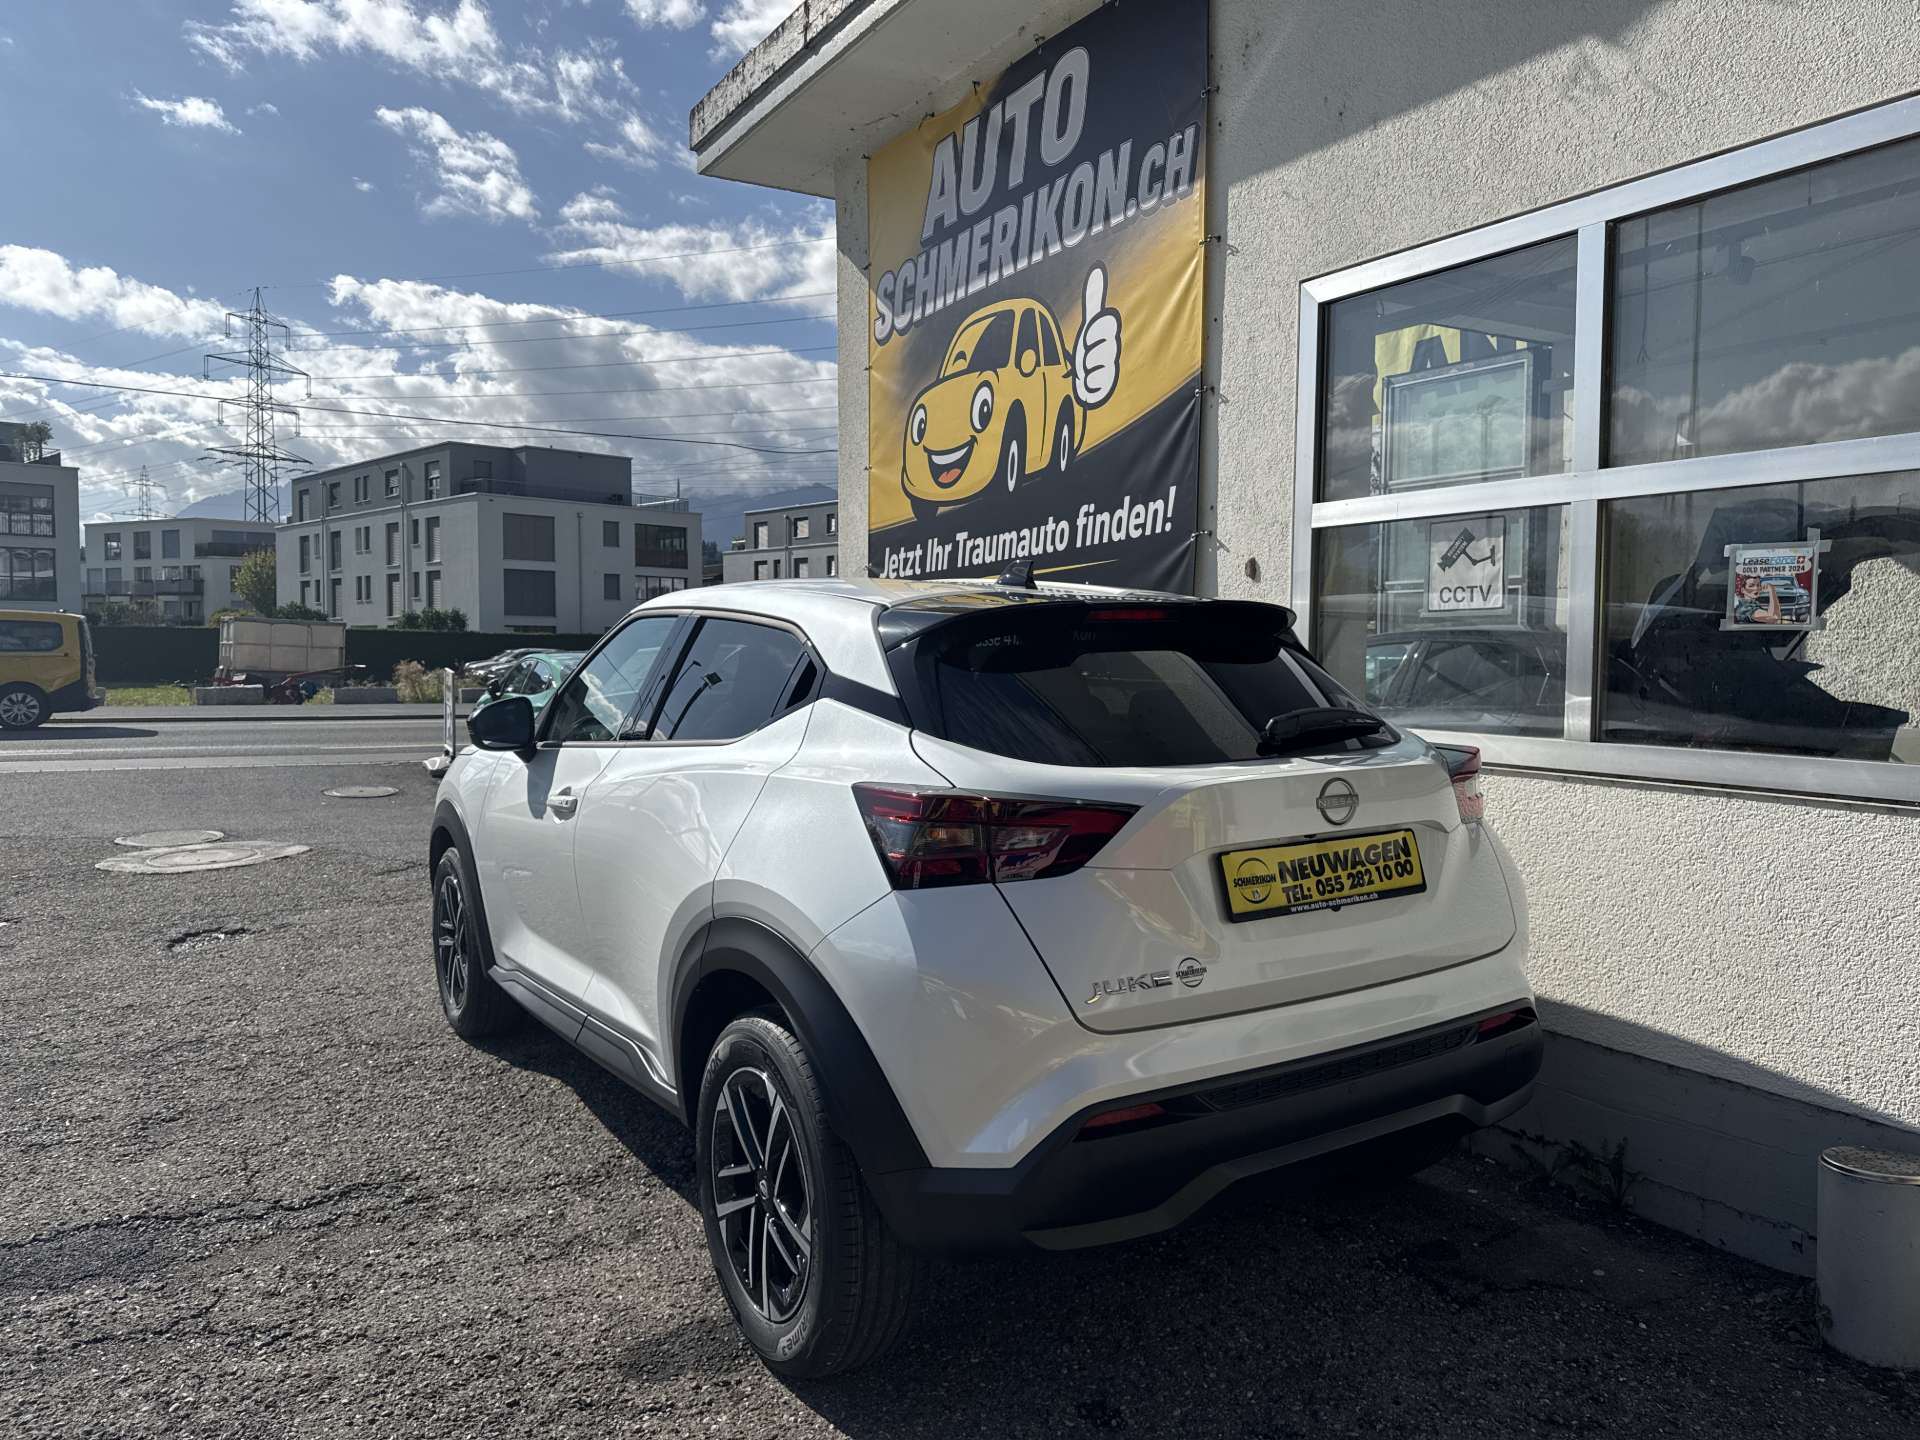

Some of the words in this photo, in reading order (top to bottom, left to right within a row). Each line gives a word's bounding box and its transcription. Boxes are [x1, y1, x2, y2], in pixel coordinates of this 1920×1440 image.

[921, 46, 1090, 244] AUTO
[874, 124, 1198, 344] SCHMERIKON.CH
[879, 547, 923, 580] Jetzt
[926, 537, 952, 572] Ihr
[956, 516, 1070, 568] Traumauto
[1076, 485, 1177, 548] finden!
[1788, 564, 1805, 573] 2024
[1439, 584, 1492, 604] CCTV
[1233, 873, 1277, 888] SCHMERIKON
[1278, 837, 1412, 884] NEUWAGEN
[1282, 883, 1313, 905] TEL:
[1315, 874, 1345, 897] 055
[1347, 868, 1375, 890] 282
[1376, 863, 1393, 883] 10
[1394, 859, 1414, 878] 00
[1085, 970, 1173, 1005] JUKE
